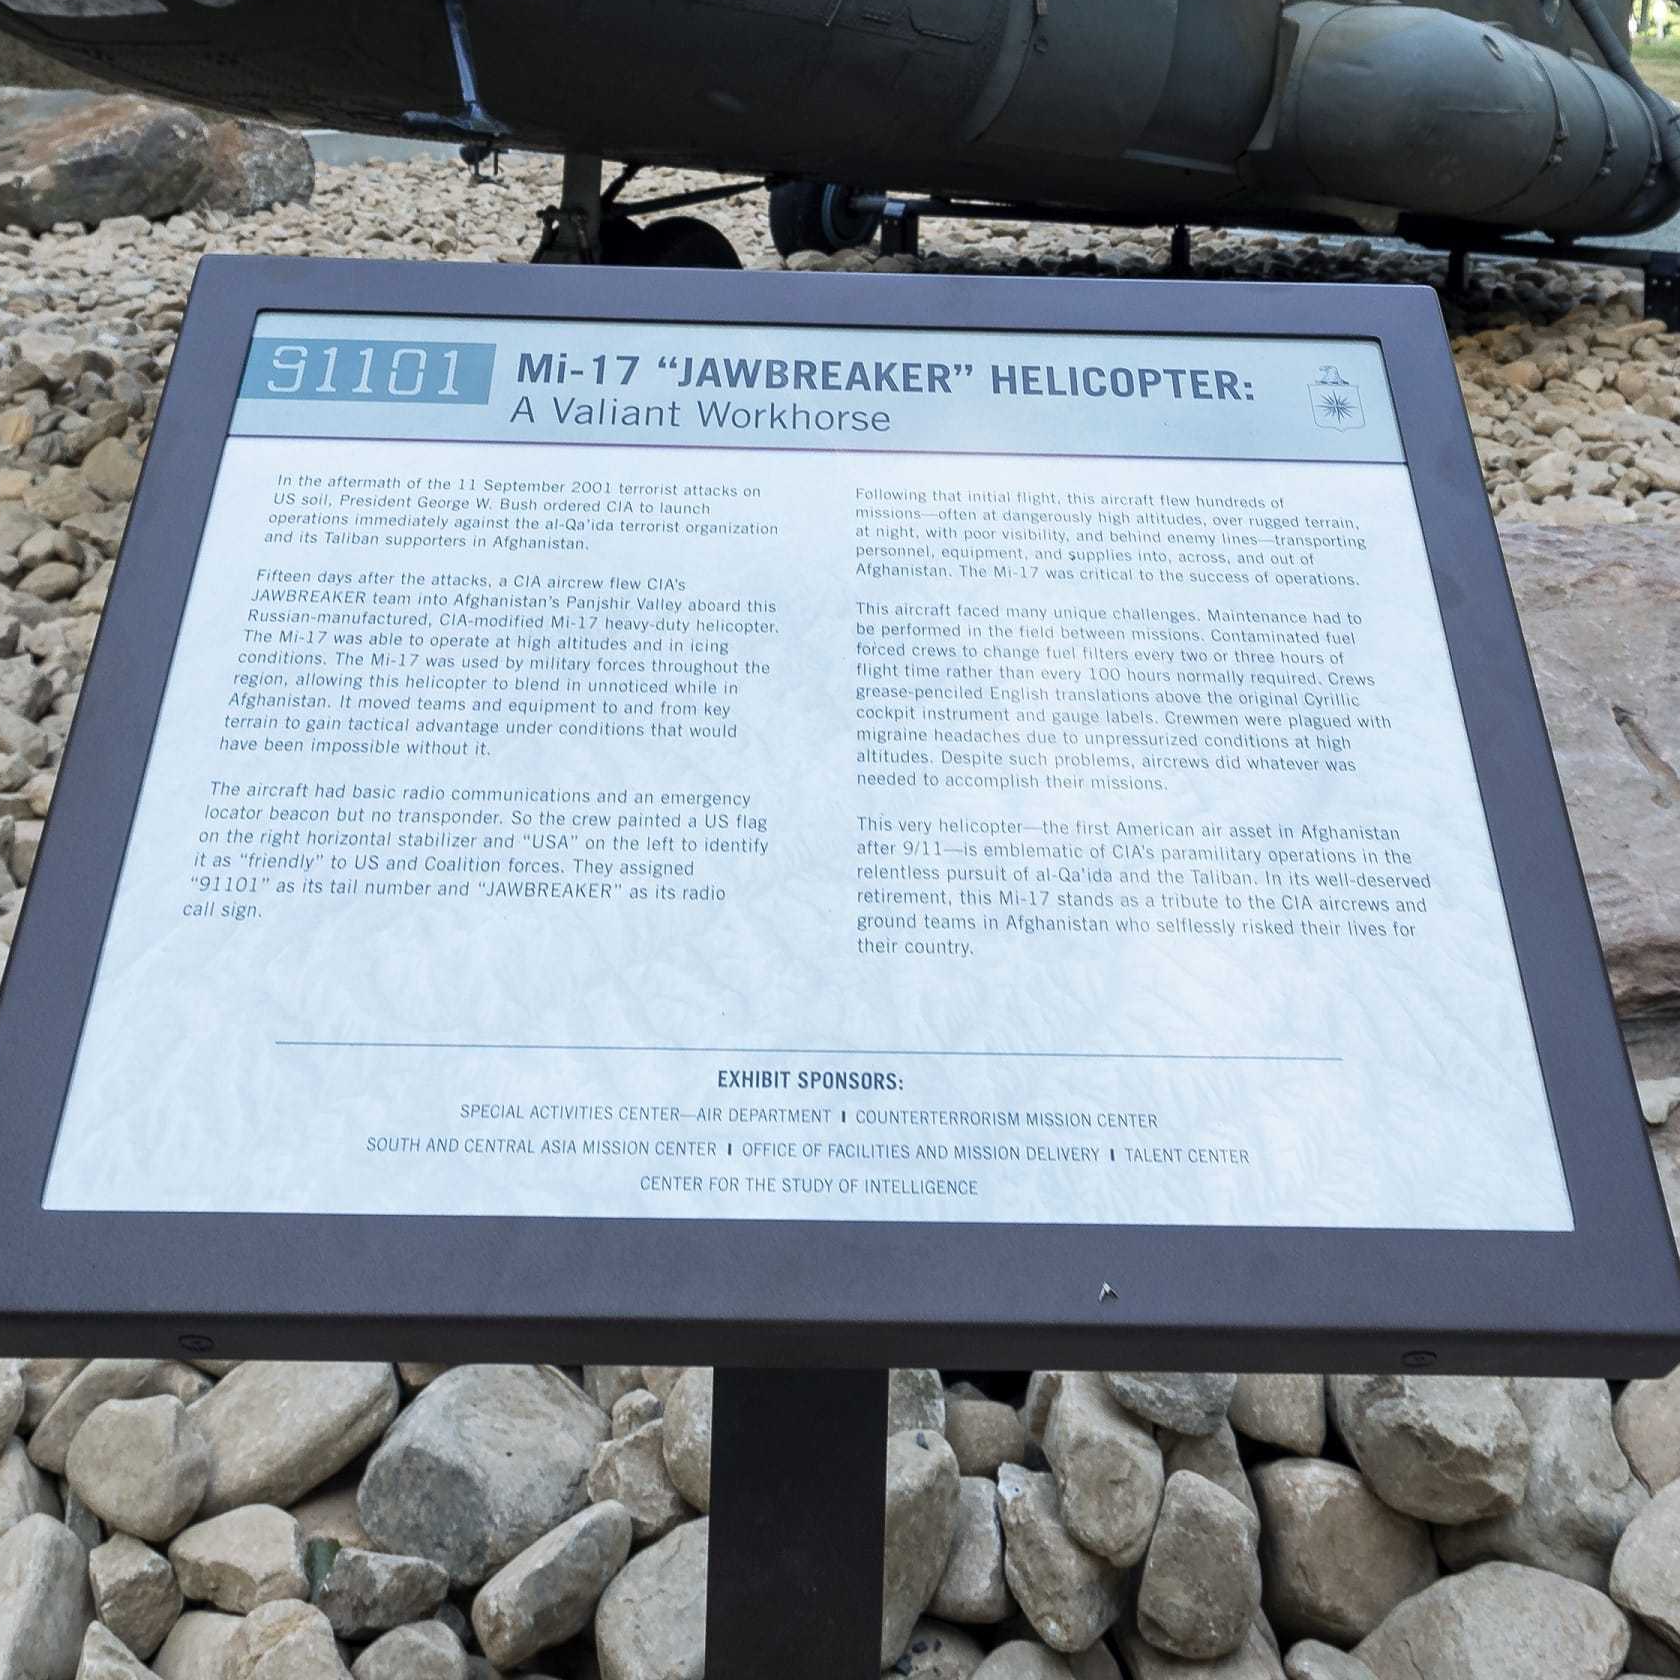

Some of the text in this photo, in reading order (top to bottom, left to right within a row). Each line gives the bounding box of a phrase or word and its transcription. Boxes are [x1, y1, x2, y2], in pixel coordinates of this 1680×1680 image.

[266, 345, 461, 396] 91101
[516, 351, 1255, 402] Mi-17 “JAWBREAKER” HELICOPTER:
[508, 394, 891, 433] A Valiant Workhorse
[276, 473, 761, 498] In the aftermath of the 11 September 2001 terrorist attacks on
[263, 529, 590, 552] and its Taliban supporters in Afghanistan.
[246, 607, 780, 637] Russian-manufactured, CIA-modified Mi-17 heavy-duty helicopter.
[855, 600, 1363, 626] This aircraft faced many unique challenges. Maintenance had to
[243, 627, 729, 657] The Mi-17 was able to operate at high altitudes and in icing
[854, 684, 1361, 710] grease-penciled English translations above the original Cyrillic
[223, 713, 738, 739] terrain to gain tactical advantage under conditions that would
[855, 725, 1352, 753] migraine headaches due to unpressurized conditions at high
[209, 779, 751, 809] The aircraft had basic radio communications and an emergency
[855, 770, 1169, 792] needed to accomplish their missions.
[192, 850, 695, 879] it as “friendly” to US and Coalition forces. They assigned
[856, 887, 1428, 913] retirement, this Mi-17 stands as a tribute to the CIA aircrews and
[855, 912, 1417, 938] ground teams in Afghanistan who selflessly risked their lives for
[717, 1068, 904, 1091] EXHIBIT SPONSORS:
[459, 1102, 525, 1120] SPECIAL
[528, 1104, 614, 1121] ACTIVITIES
[727, 1106, 832, 1124] DEPARTMENT
[855, 1108, 1021, 1127] COUNTERTERRORISM
[1024, 1110, 1093, 1129] MISSION
[1095, 1111, 1159, 1129] CENTER
[365, 1135, 1250, 1165] SOUTH AND CENTRAL ASIA MISSION CENTER OFFICE OF FACILITIES AND MISSION DELIVERY TALENT CENTER
[639, 1174, 979, 1196] CENTER FOR THE STUDY OF INTELLIGENCE
